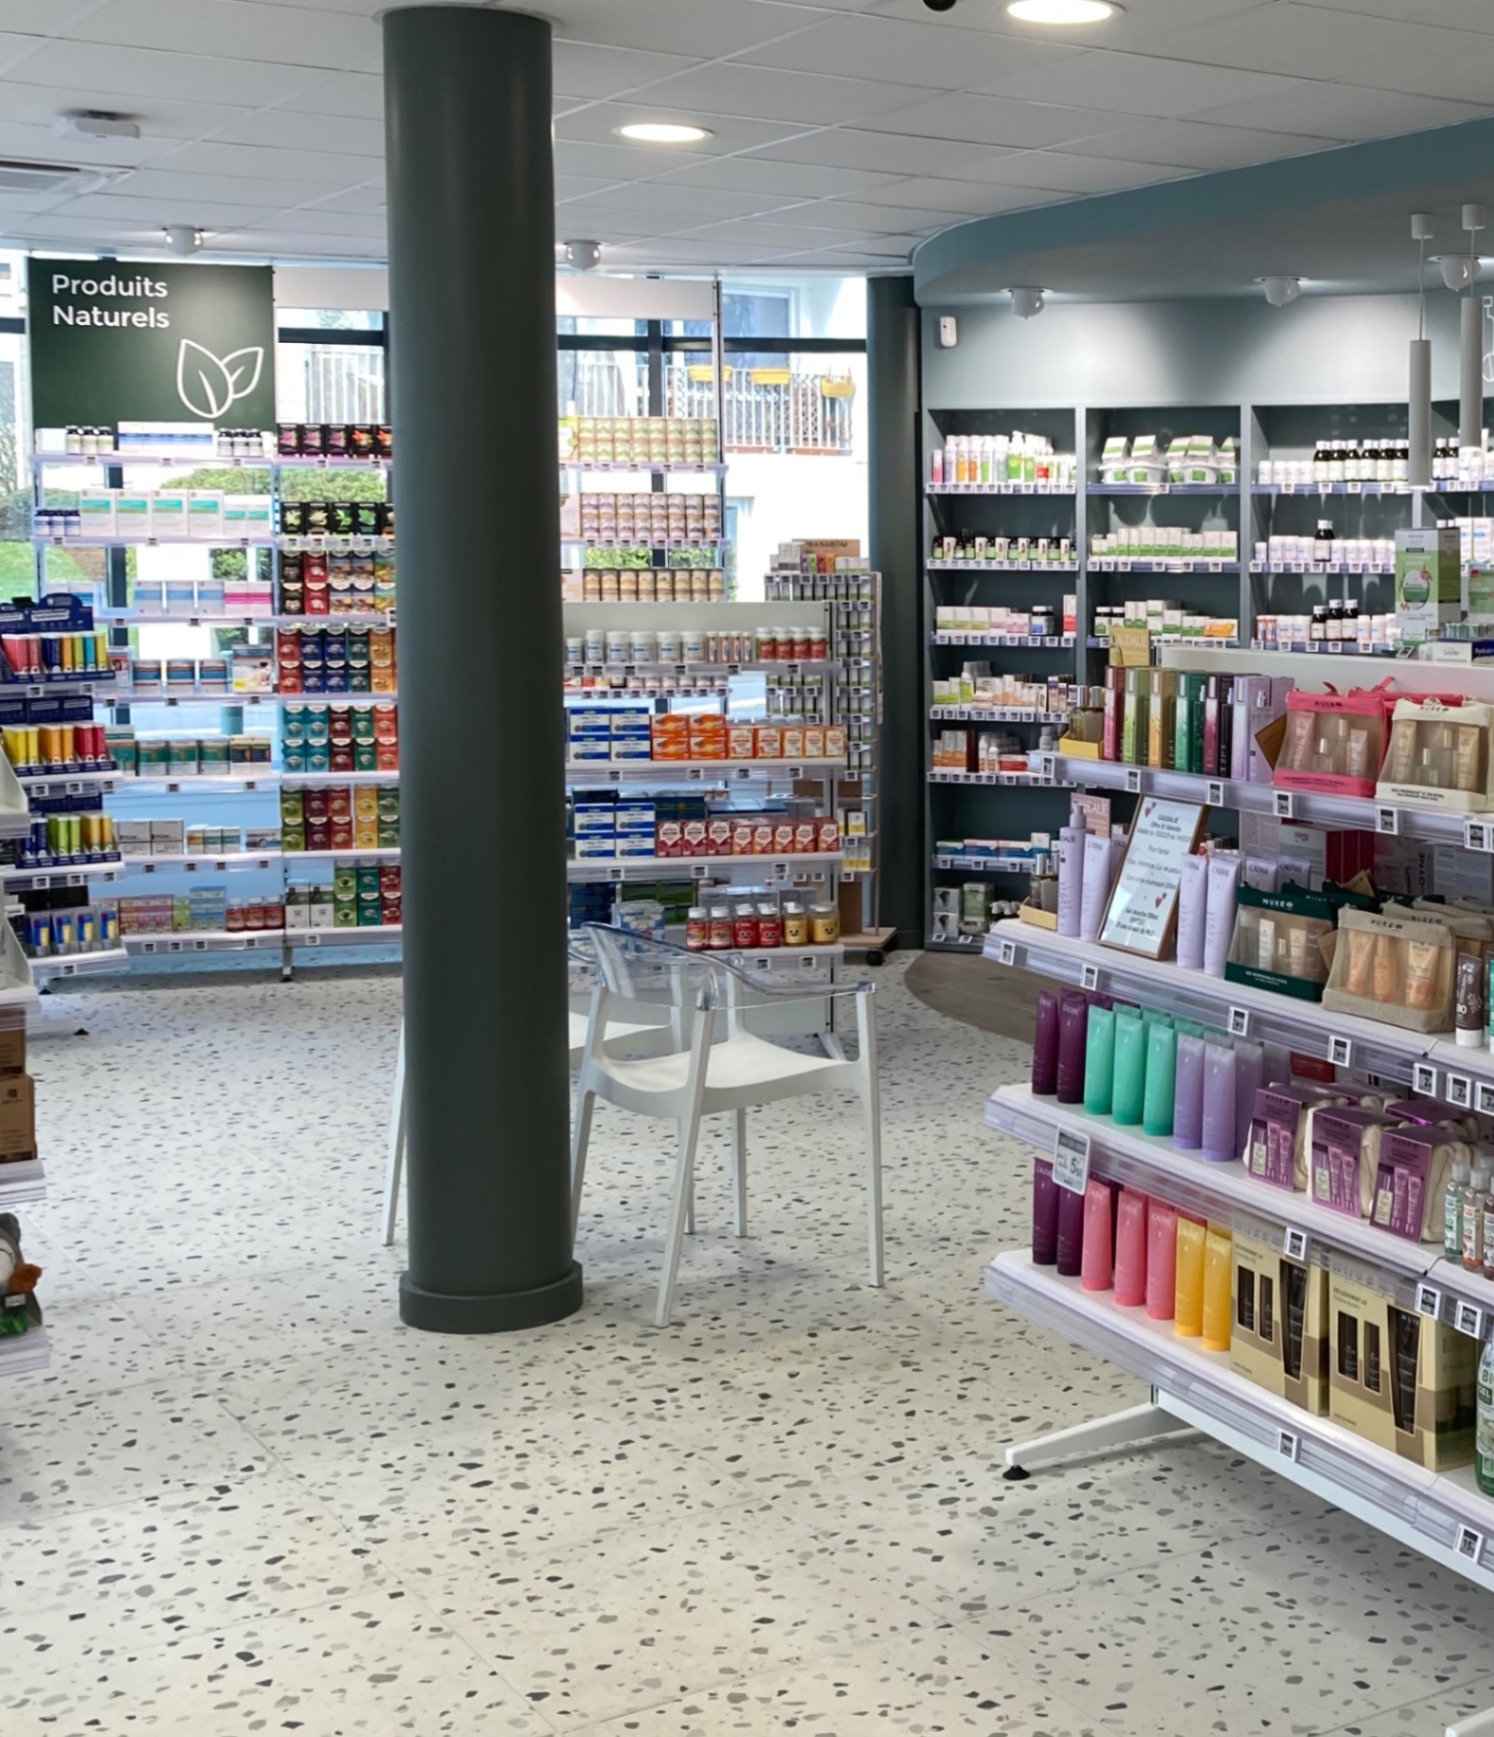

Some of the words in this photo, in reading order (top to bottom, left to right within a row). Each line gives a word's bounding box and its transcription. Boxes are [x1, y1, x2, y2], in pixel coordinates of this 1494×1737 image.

[52, 274, 168, 298] Produits
[53, 305, 170, 328] Naturels
[1262, 898, 1286, 907] NUXE
